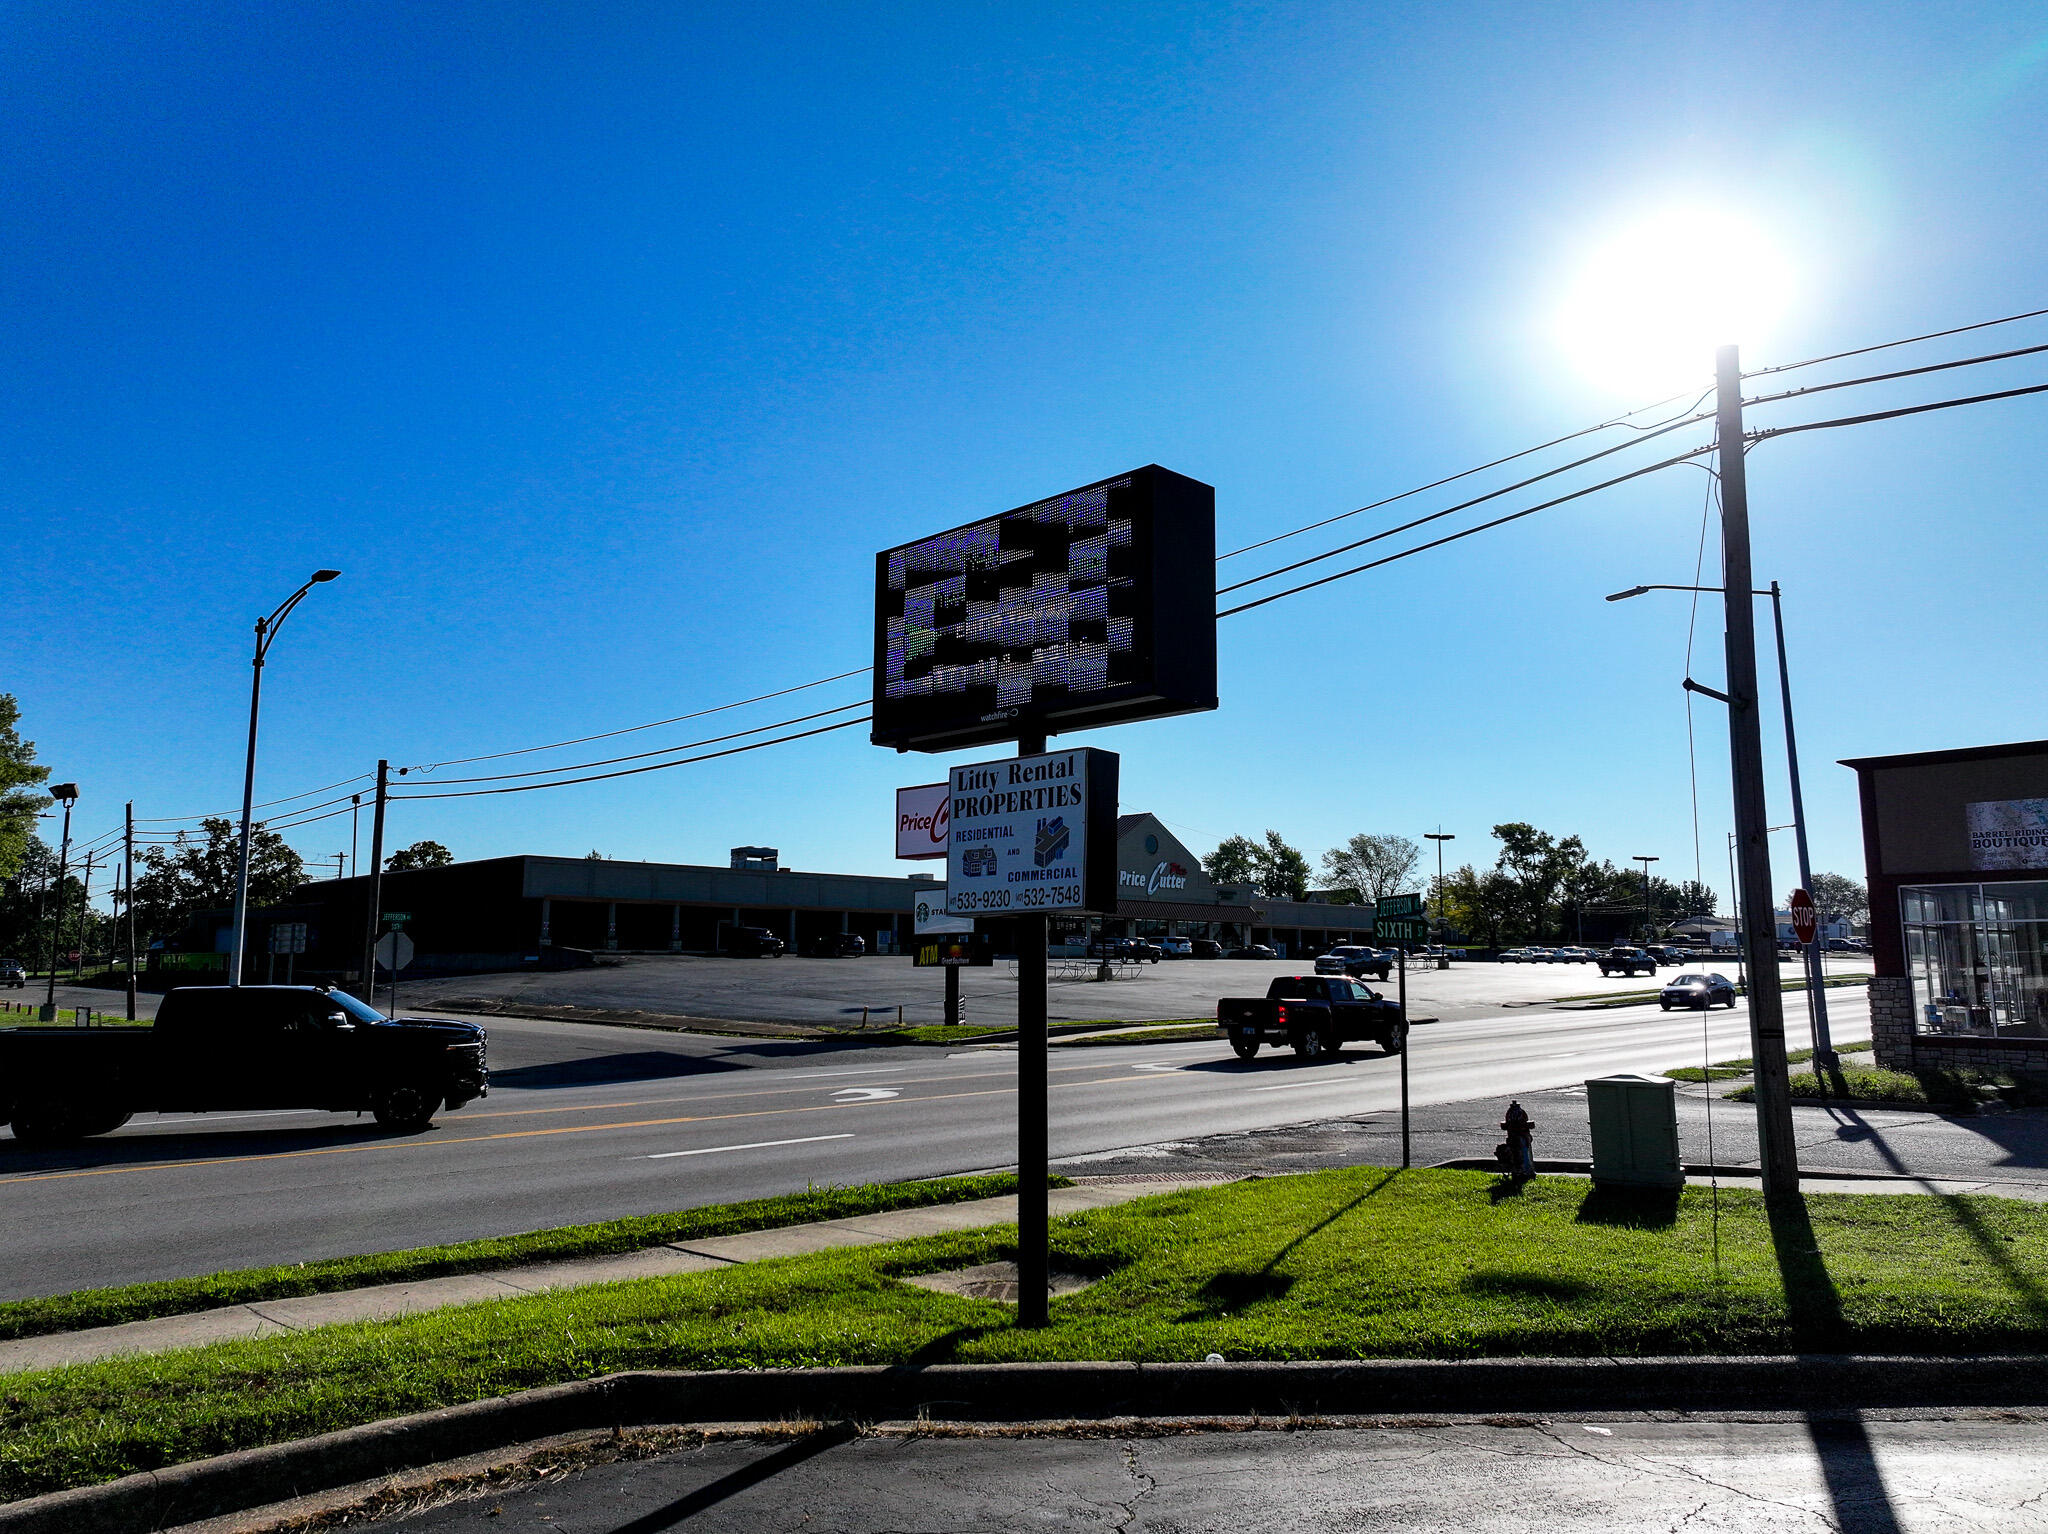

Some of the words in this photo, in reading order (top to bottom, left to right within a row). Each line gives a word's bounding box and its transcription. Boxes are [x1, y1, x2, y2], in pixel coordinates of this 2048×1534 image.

[981, 710, 1008, 722] watchfire
[958, 769, 999, 793] Litty
[1007, 754, 1075, 785] Rental
[953, 782, 1082, 819] PROPERTIES
[900, 812, 932, 832] Price
[956, 825, 1014, 843] RESIDENTIAL
[1973, 836, 2048, 849] BOUTIQUE
[2014, 828, 2048, 837] RIDING
[1007, 848, 1020, 856] AND
[1007, 867, 1078, 883] COMMERCIAL
[1119, 870, 1146, 887] Price
[1147, 861, 1186, 895] Cutter
[957, 889, 1011, 910] 533-9230
[1023, 885, 1080, 907] 532-7548
[1379, 896, 1412, 917] JEFFERSON
[1793, 906, 1814, 927] STOP
[1376, 921, 1412, 939] SIXTH
[919, 944, 938, 966] ATM
